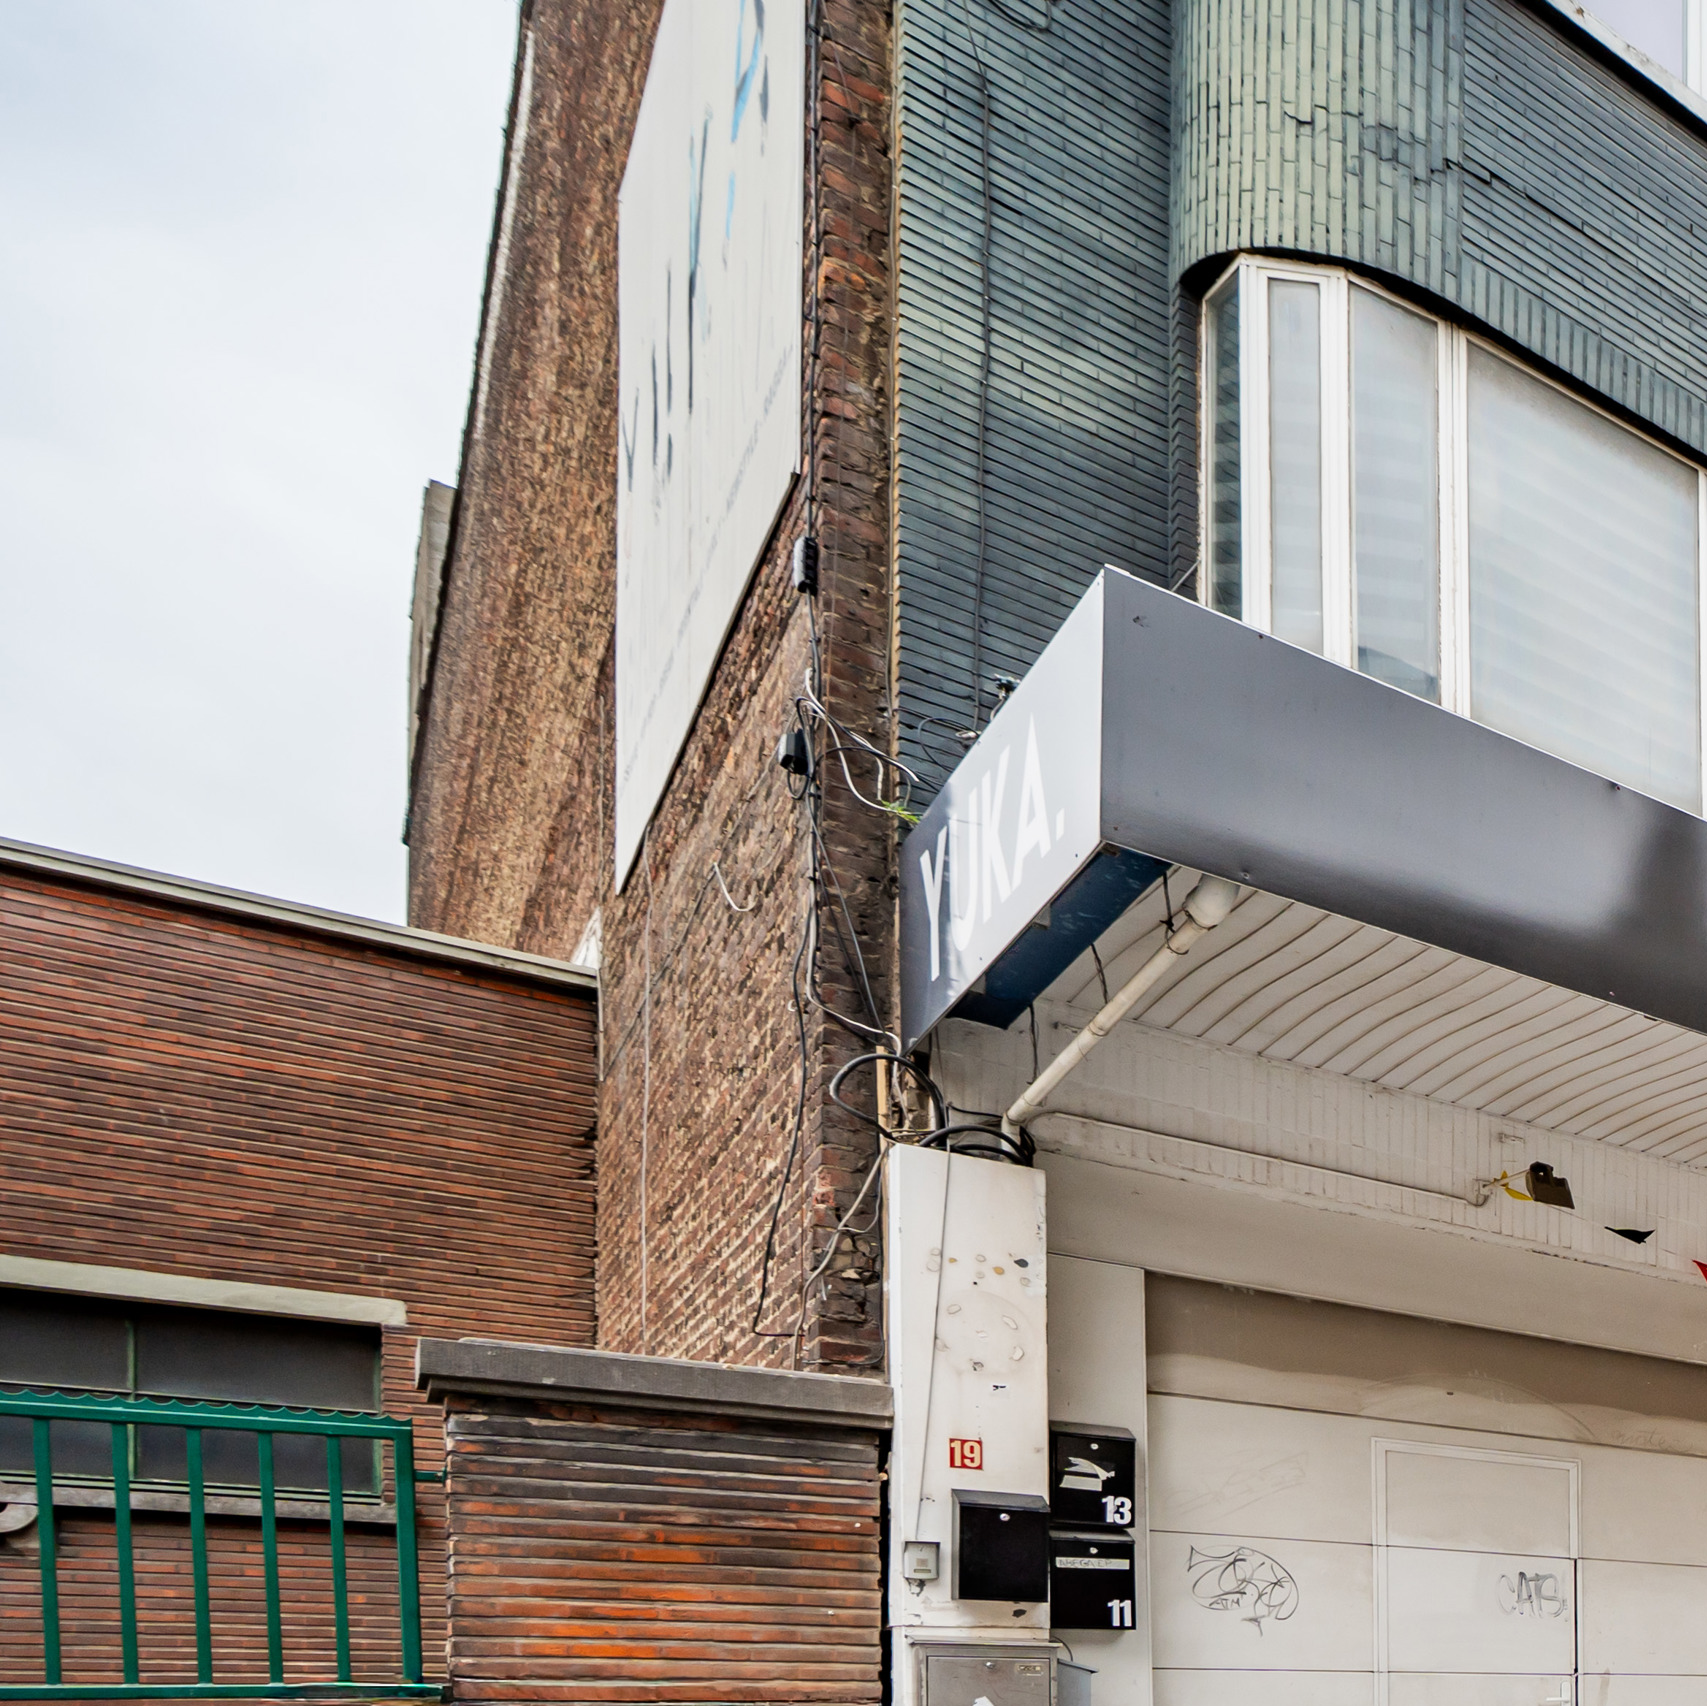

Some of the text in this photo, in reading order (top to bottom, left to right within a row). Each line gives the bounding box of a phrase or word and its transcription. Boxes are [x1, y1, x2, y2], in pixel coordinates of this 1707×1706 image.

[918, 714, 1065, 983] YUKA.
[951, 1440, 982, 1469] 19
[1101, 1495, 1132, 1525] 13
[1107, 1599, 1132, 1627] 11
